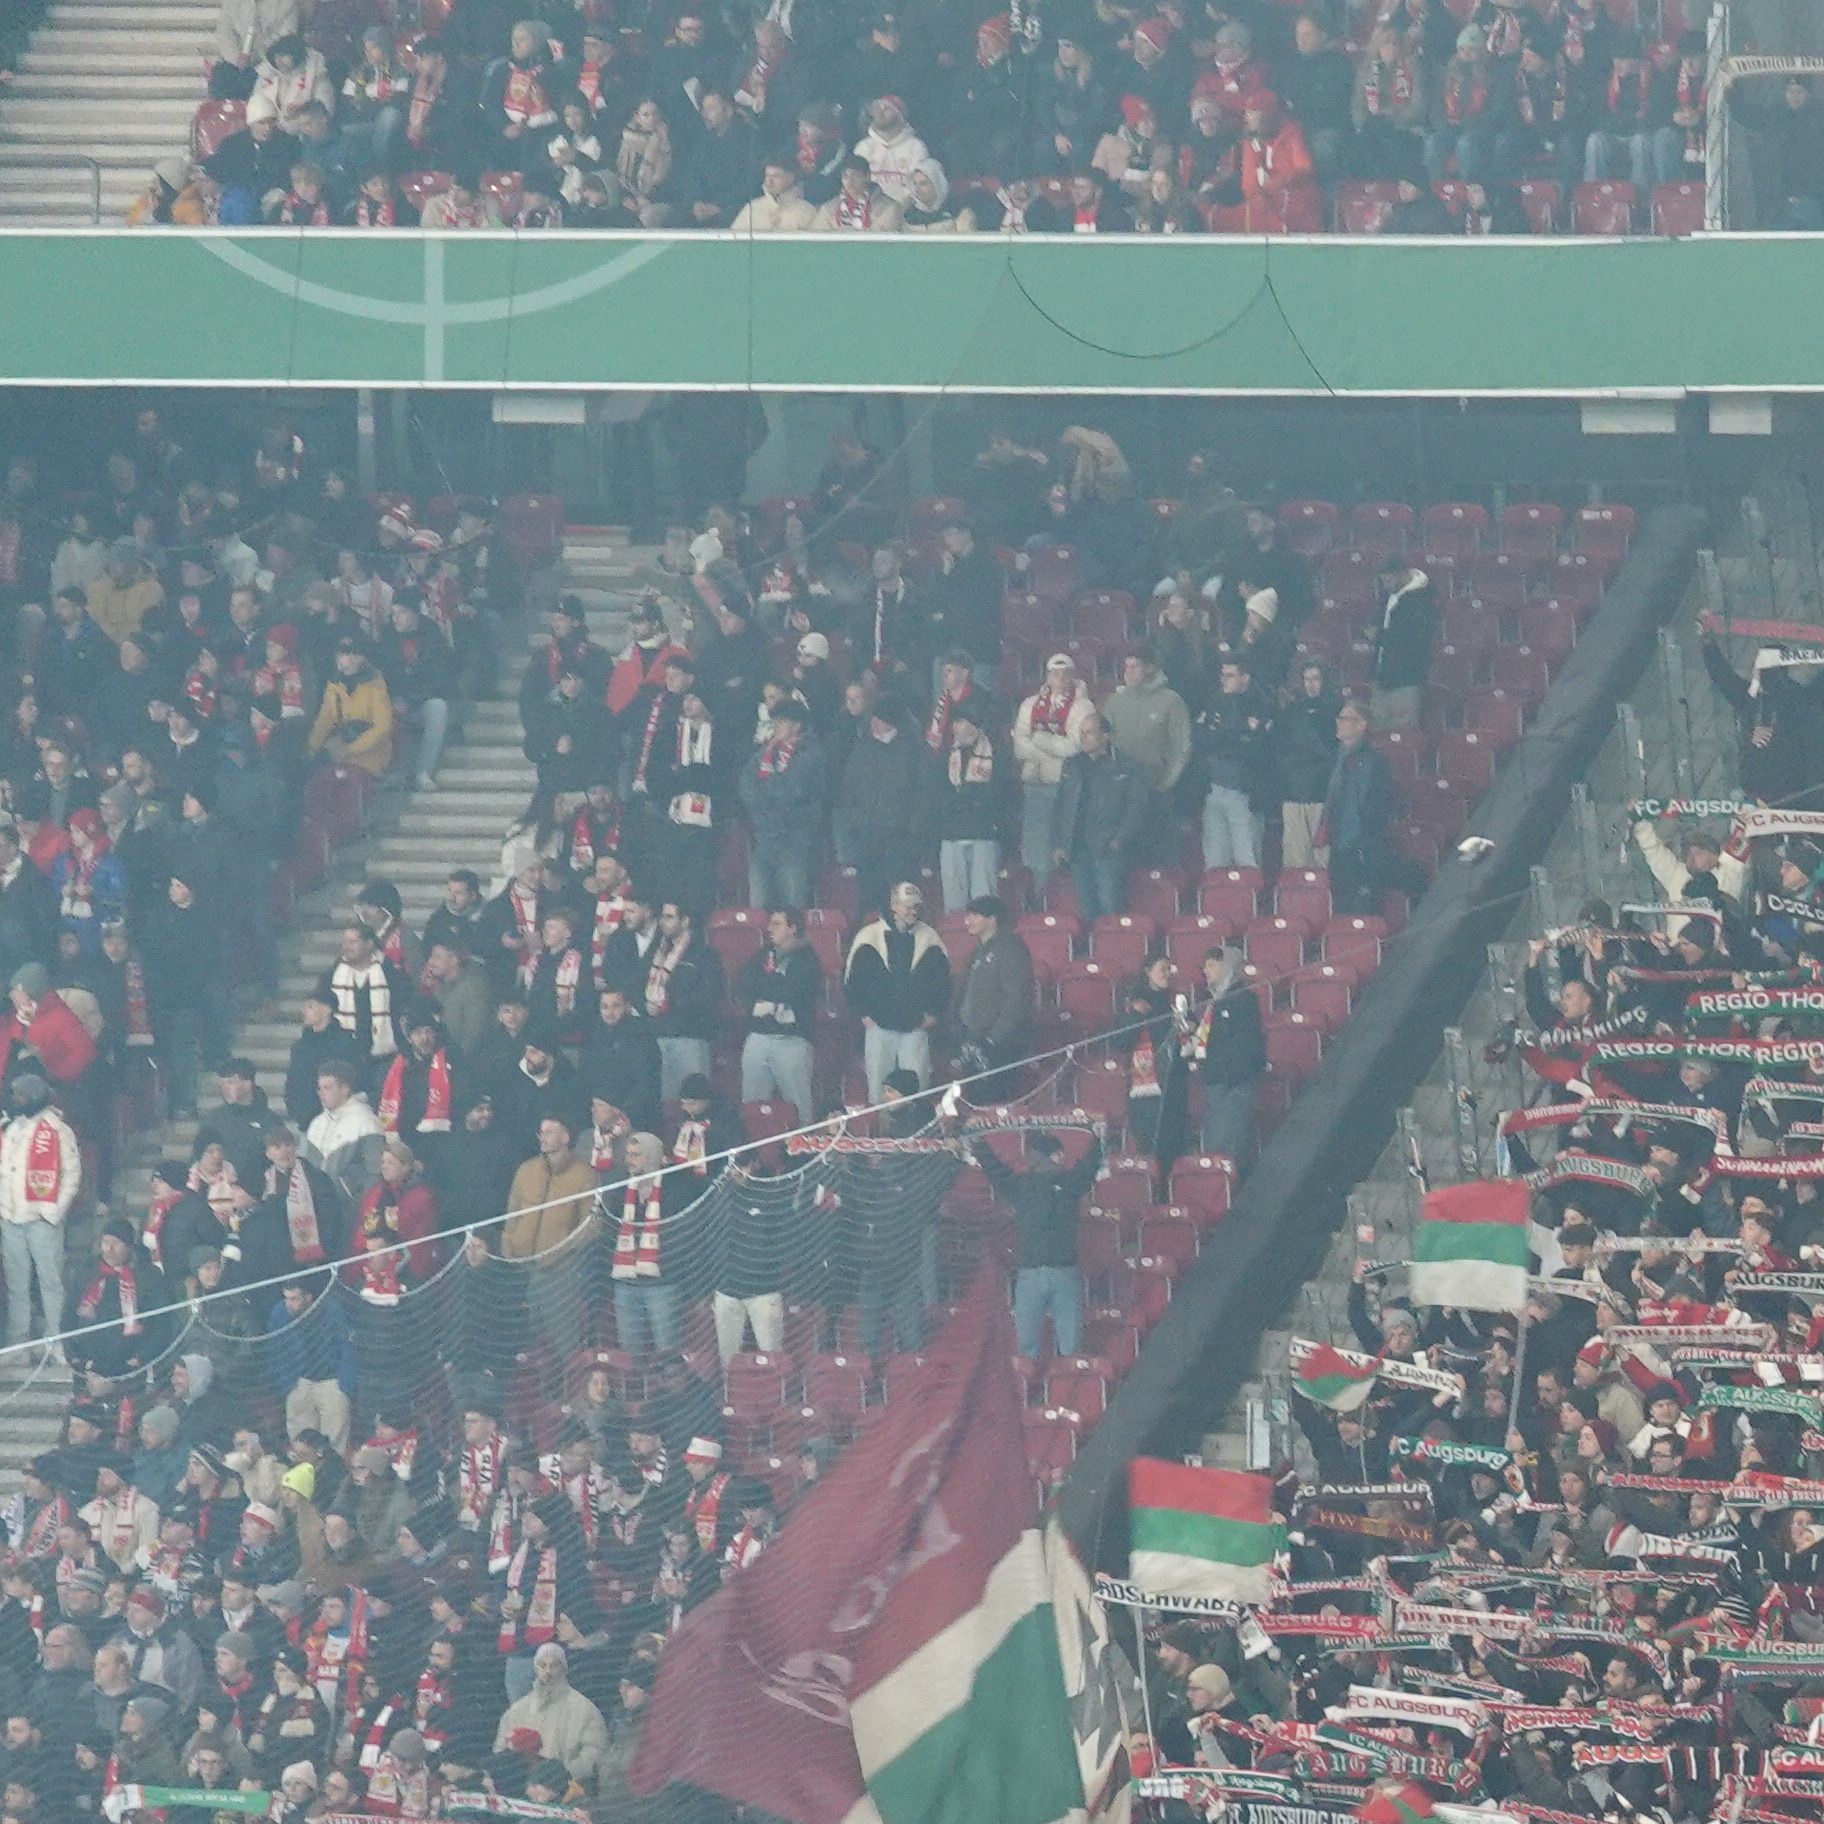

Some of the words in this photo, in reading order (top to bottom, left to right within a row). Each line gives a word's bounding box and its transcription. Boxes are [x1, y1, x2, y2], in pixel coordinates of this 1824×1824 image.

[1700, 992, 1769, 1012] REGIO
[1598, 1042, 1674, 1059] REGIO
[1680, 1041, 1751, 1059] THOR
[1757, 1040, 1824, 1063] REGIO
[1417, 1440, 1510, 1469] Augsburg
